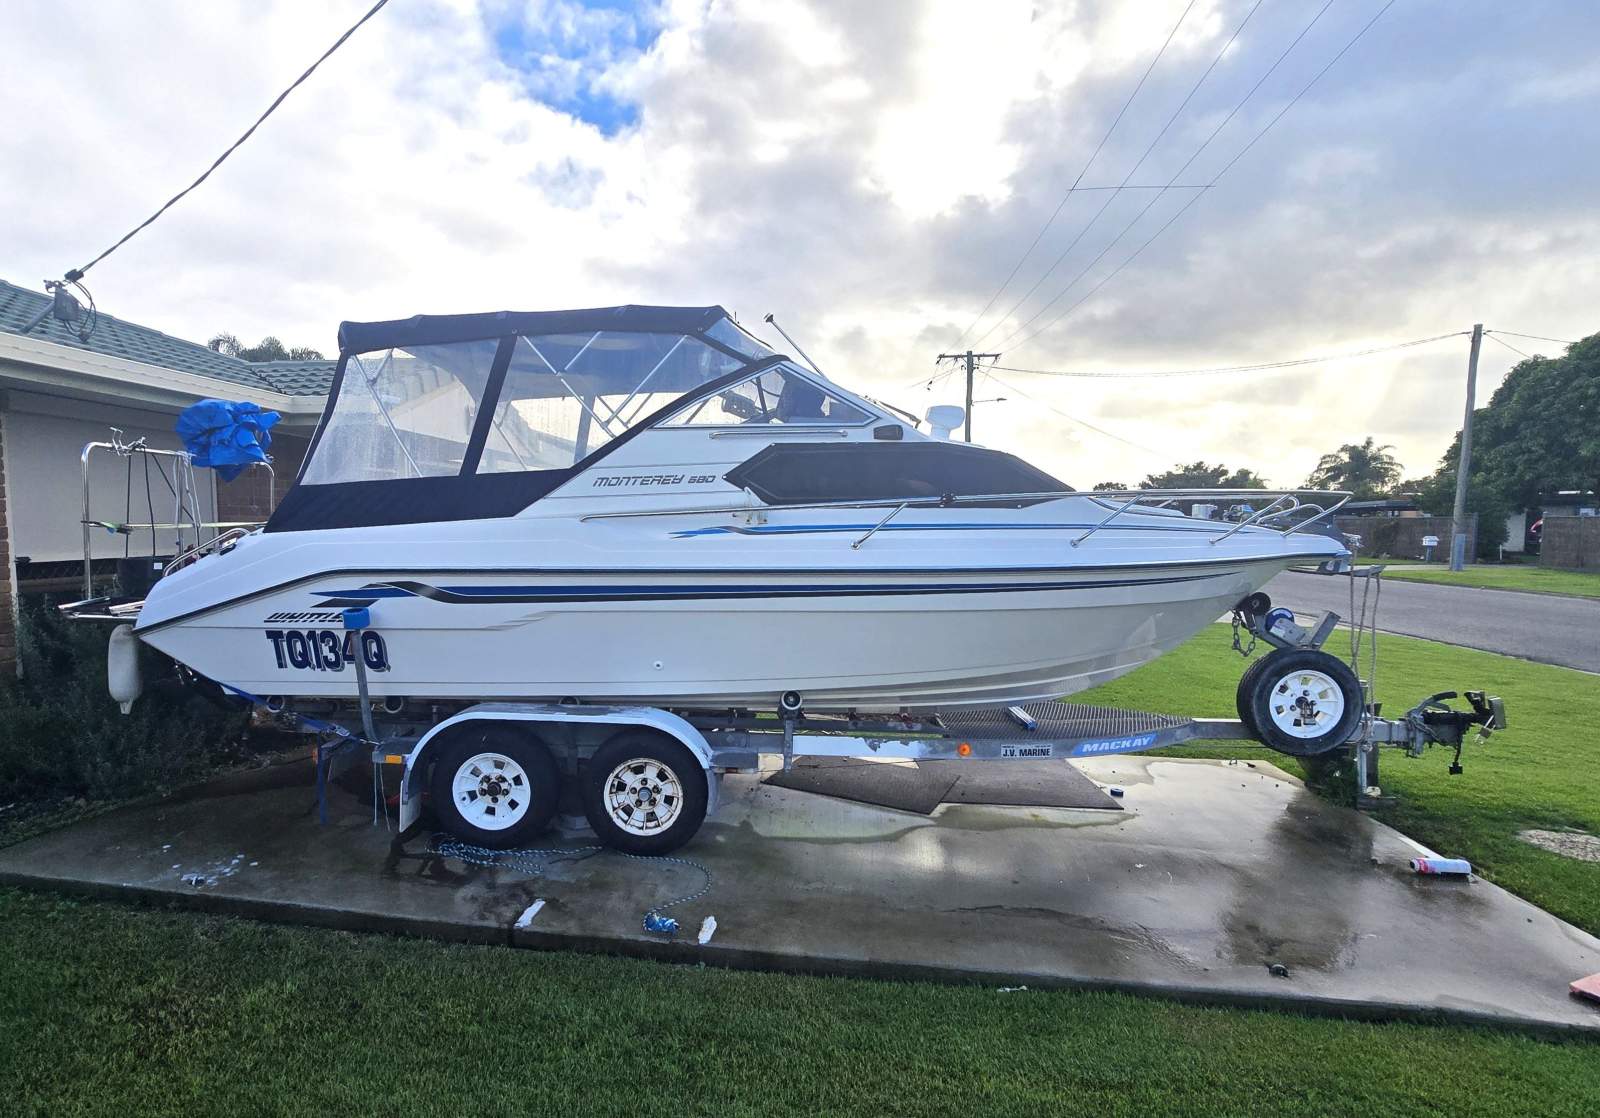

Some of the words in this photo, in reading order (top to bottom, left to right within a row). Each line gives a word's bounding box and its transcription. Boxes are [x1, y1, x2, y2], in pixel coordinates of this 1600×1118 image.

[592, 474, 685, 487] MONTEREY
[265, 630, 391, 672] TQ134Q
[1082, 737, 1151, 753] MACKAY
[1019, 748, 1051, 757] MARINE
